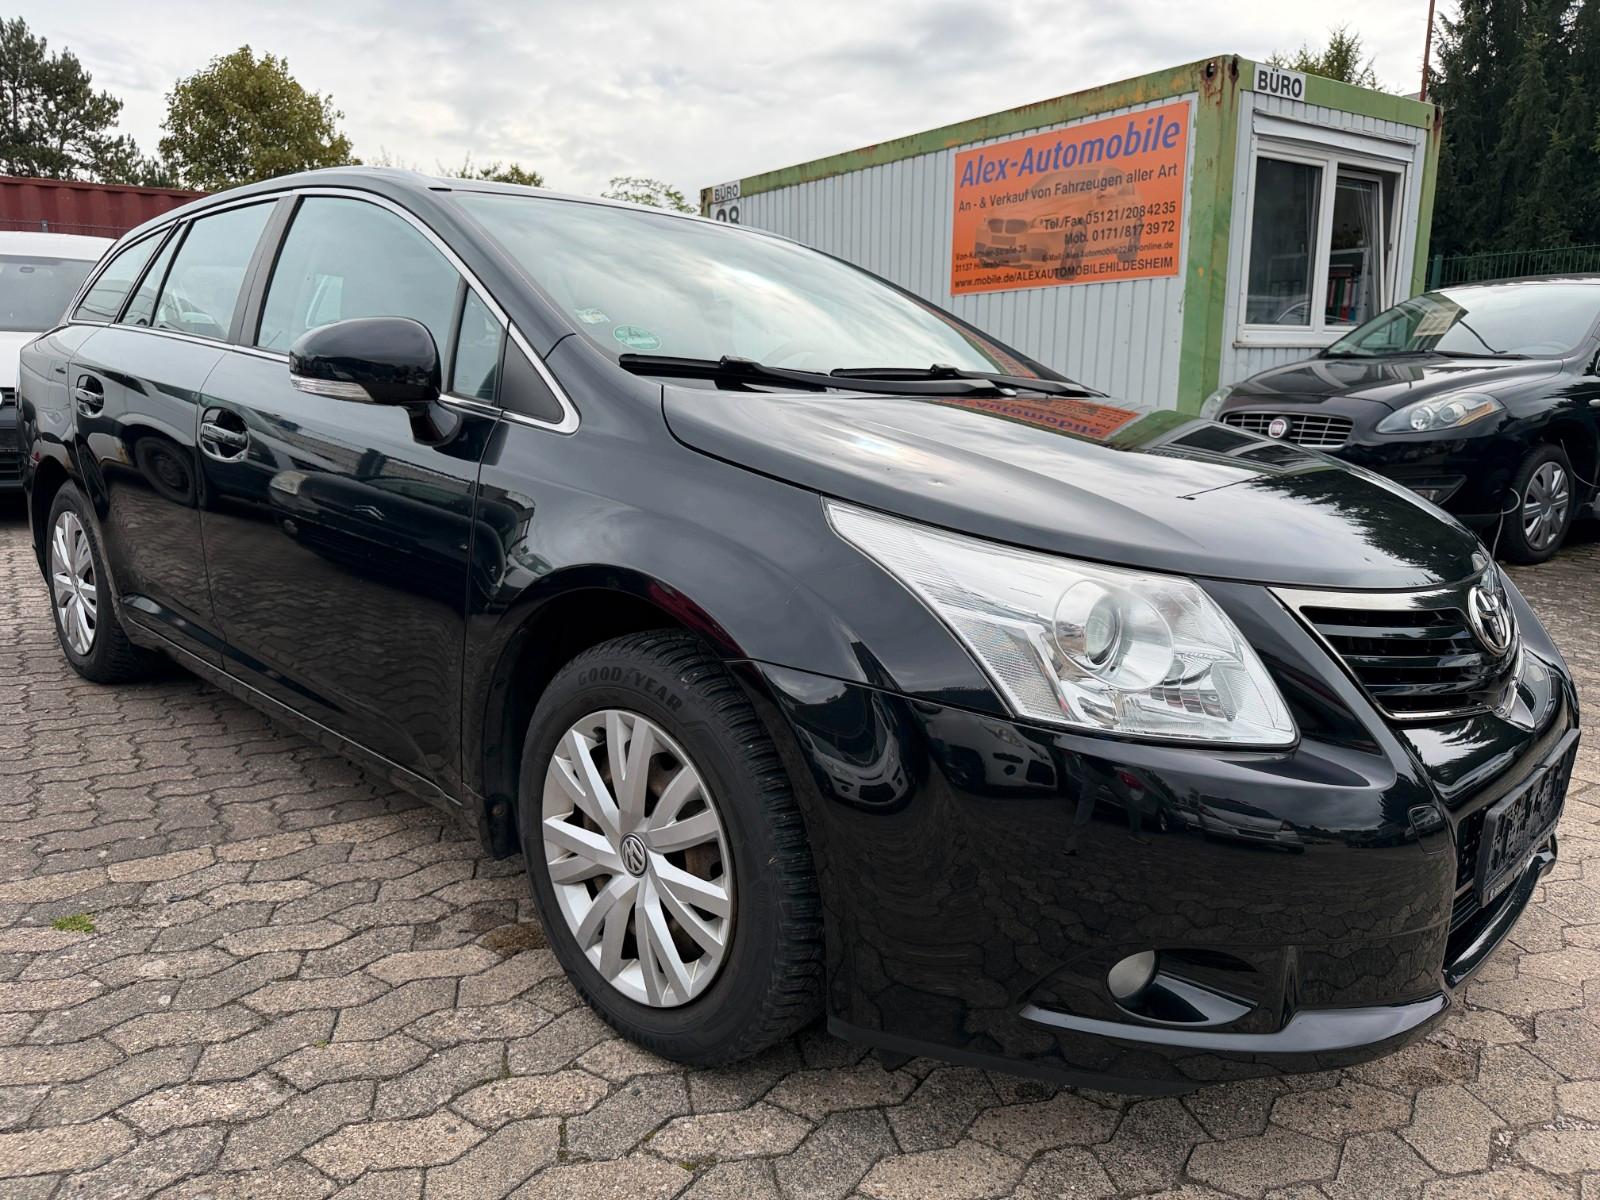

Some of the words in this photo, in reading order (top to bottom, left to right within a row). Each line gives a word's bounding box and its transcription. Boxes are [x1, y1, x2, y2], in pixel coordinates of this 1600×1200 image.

[1257, 67, 1303, 98] BÜRO
[959, 114, 1181, 188] Alex-Automobile
[714, 183, 739, 201] BÜRO
[979, 196, 987, 209] &
[989, 187, 1029, 207] Verkauf
[1030, 186, 1052, 200] von
[1054, 174, 1123, 196] Fahrzeugen
[1125, 168, 1154, 184] aller
[1157, 162, 1178, 179] Art
[1064, 232, 1088, 245] Mob.
